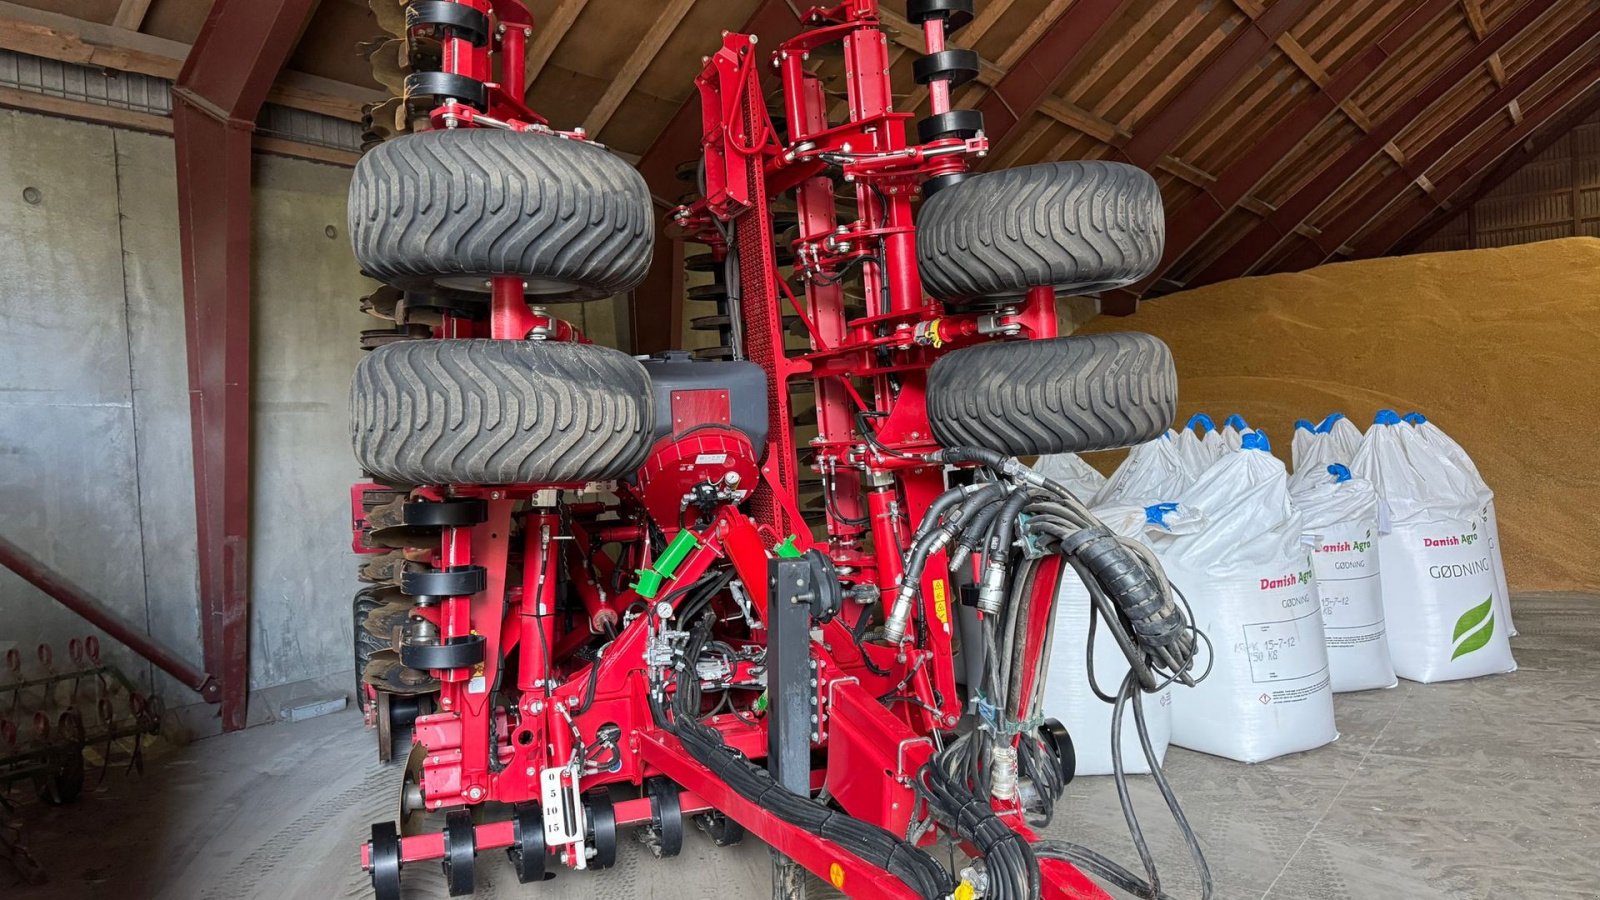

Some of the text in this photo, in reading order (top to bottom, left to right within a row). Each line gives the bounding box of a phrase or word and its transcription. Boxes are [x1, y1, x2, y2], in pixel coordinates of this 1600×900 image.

[1314, 540, 1371, 553] anish Agro
[1424, 535, 1459, 547] Danish
[1461, 533, 1478, 545] Agro
[1334, 560, 1366, 570] GØDNING
[1429, 557, 1489, 579] GØDNING
[1260, 570, 1312, 590] Danish Agro
[1281, 593, 1310, 609] GØDNING
[1264, 636, 1296, 651] 15-7-12
[548, 773, 555, 781] 0
[550, 789, 557, 798] 5
[546, 806, 558, 816] 10
[548, 823, 560, 833] 15
